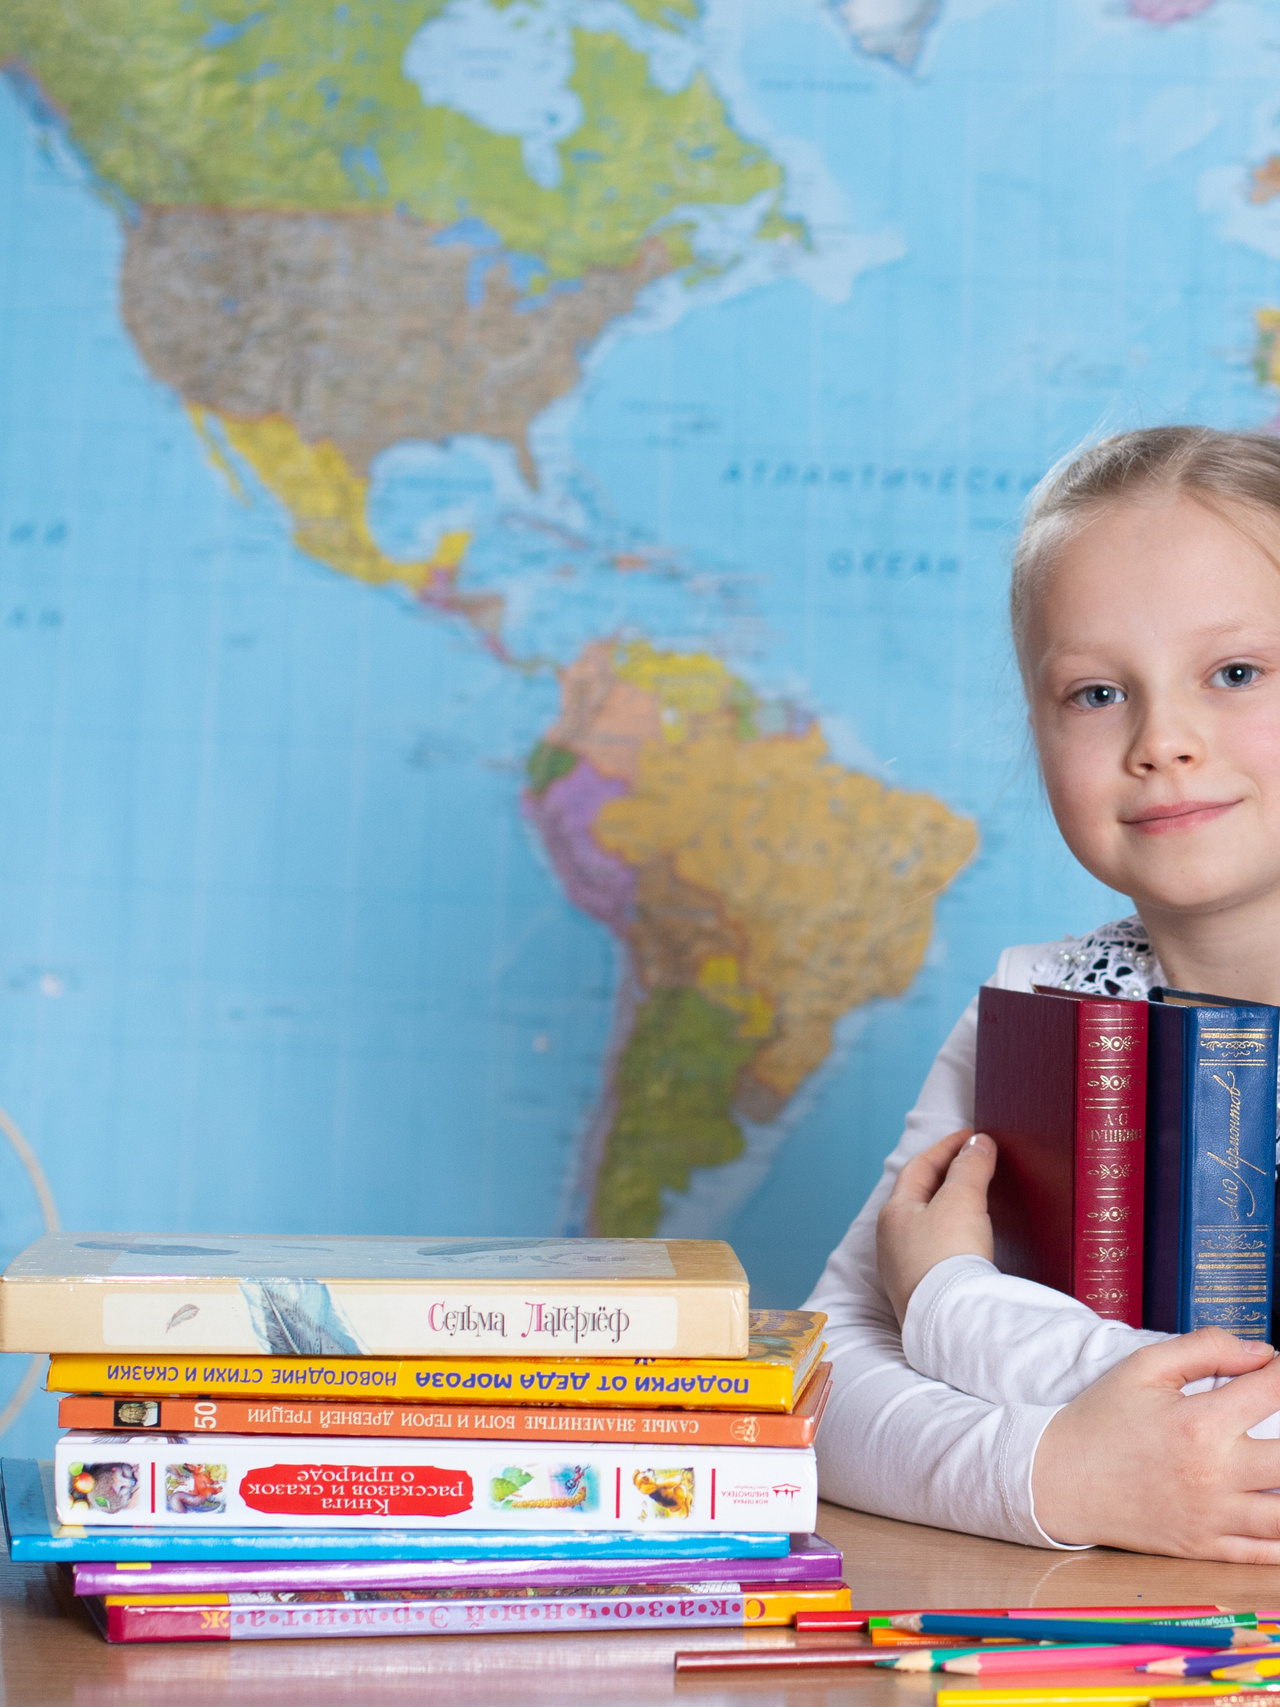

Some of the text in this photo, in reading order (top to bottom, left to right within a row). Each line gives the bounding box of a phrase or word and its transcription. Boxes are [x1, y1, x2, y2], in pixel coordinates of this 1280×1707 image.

[722, 457, 1042, 494] АТЛАНТИЧЕСКИ
[1207, 1070, 1267, 1218] Лермонтов
[427, 1301, 630, 1344] Сельма Лагерлёф
[106, 1364, 750, 1394] ПОДАРКИ ОТ ДЕДА МОРОЗА НОВОГОДНИЕ СТИХИ И СКАЗКИ
[194, 1401, 217, 1429] 50
[248, 1406, 700, 1434] САМЫЕ ЗНАМЕНИТЫЕ БОГИ И ГЕРОИ ДРЕВНЕЙ ГРЕЦИИ
[297, 1466, 415, 1484] о природе
[248, 1482, 464, 1498] рассказов и сказок
[721, 1490, 769, 1498] БИБЛИОТЕКА
[322, 1498, 390, 1514] Книга
